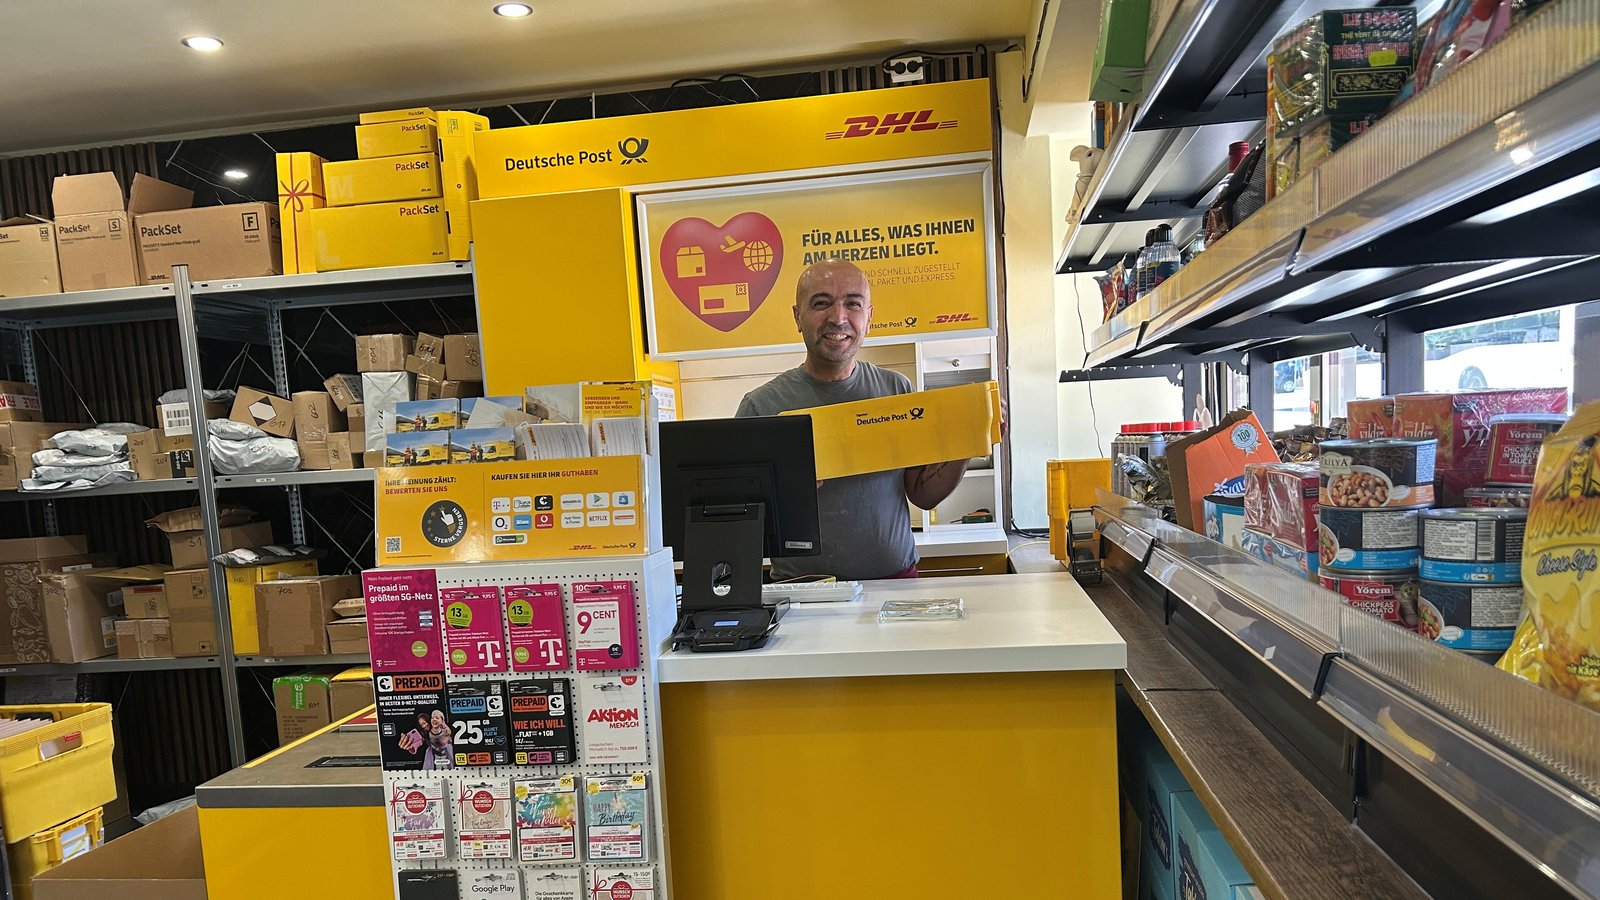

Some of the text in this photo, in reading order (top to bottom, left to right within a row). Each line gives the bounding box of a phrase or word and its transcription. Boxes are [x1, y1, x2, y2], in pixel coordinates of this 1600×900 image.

[402, 124, 426, 132] PackSet
[842, 109, 940, 138] DHL
[505, 148, 612, 171] Deutsche Post
[395, 161, 430, 171] PackSet
[400, 204, 439, 216] PackSet
[112, 221, 118, 229] S
[247, 216, 254, 228] F
[58, 224, 91, 234] PackSet
[140, 224, 182, 238] PackSet
[802, 219, 975, 247] FÜR ALLES, WAS IHNEN
[803, 241, 938, 266] AM HERZEN LIEGT.
[864, 262, 960, 278] ND SCHNELL ZUGESTELLT
[876, 278, 900, 286] PAKET
[902, 276, 920, 284] UND
[936, 313, 972, 324] DHL
[889, 320, 903, 328] Post
[856, 416, 890, 426] Deutsche
[1237, 430, 1250, 440] 100
[1508, 430, 1543, 440] Yörem
[562, 470, 598, 478] GUTHABEN
[452, 507, 464, 536] VERGEBEN
[434, 536, 456, 544] STERNE
[1537, 550, 1597, 580] Cheese Style
[368, 584, 398, 593] Prepaid
[1356, 586, 1390, 594] Yörem
[370, 592, 433, 603] größten 5G-Netz
[451, 608, 462, 617] 13
[512, 606, 523, 615] 13
[577, 610, 616, 634] 9 CENT
[395, 676, 440, 689] PREPAID
[452, 699, 484, 708] PREPAID
[513, 698, 546, 706] PREPAID
[513, 719, 566, 730] WIE ICH WILL
[609, 721, 639, 729] MENSCH
[452, 720, 483, 744] 25
[599, 811, 635, 825] Birthday
[472, 885, 514, 894] Google Play
